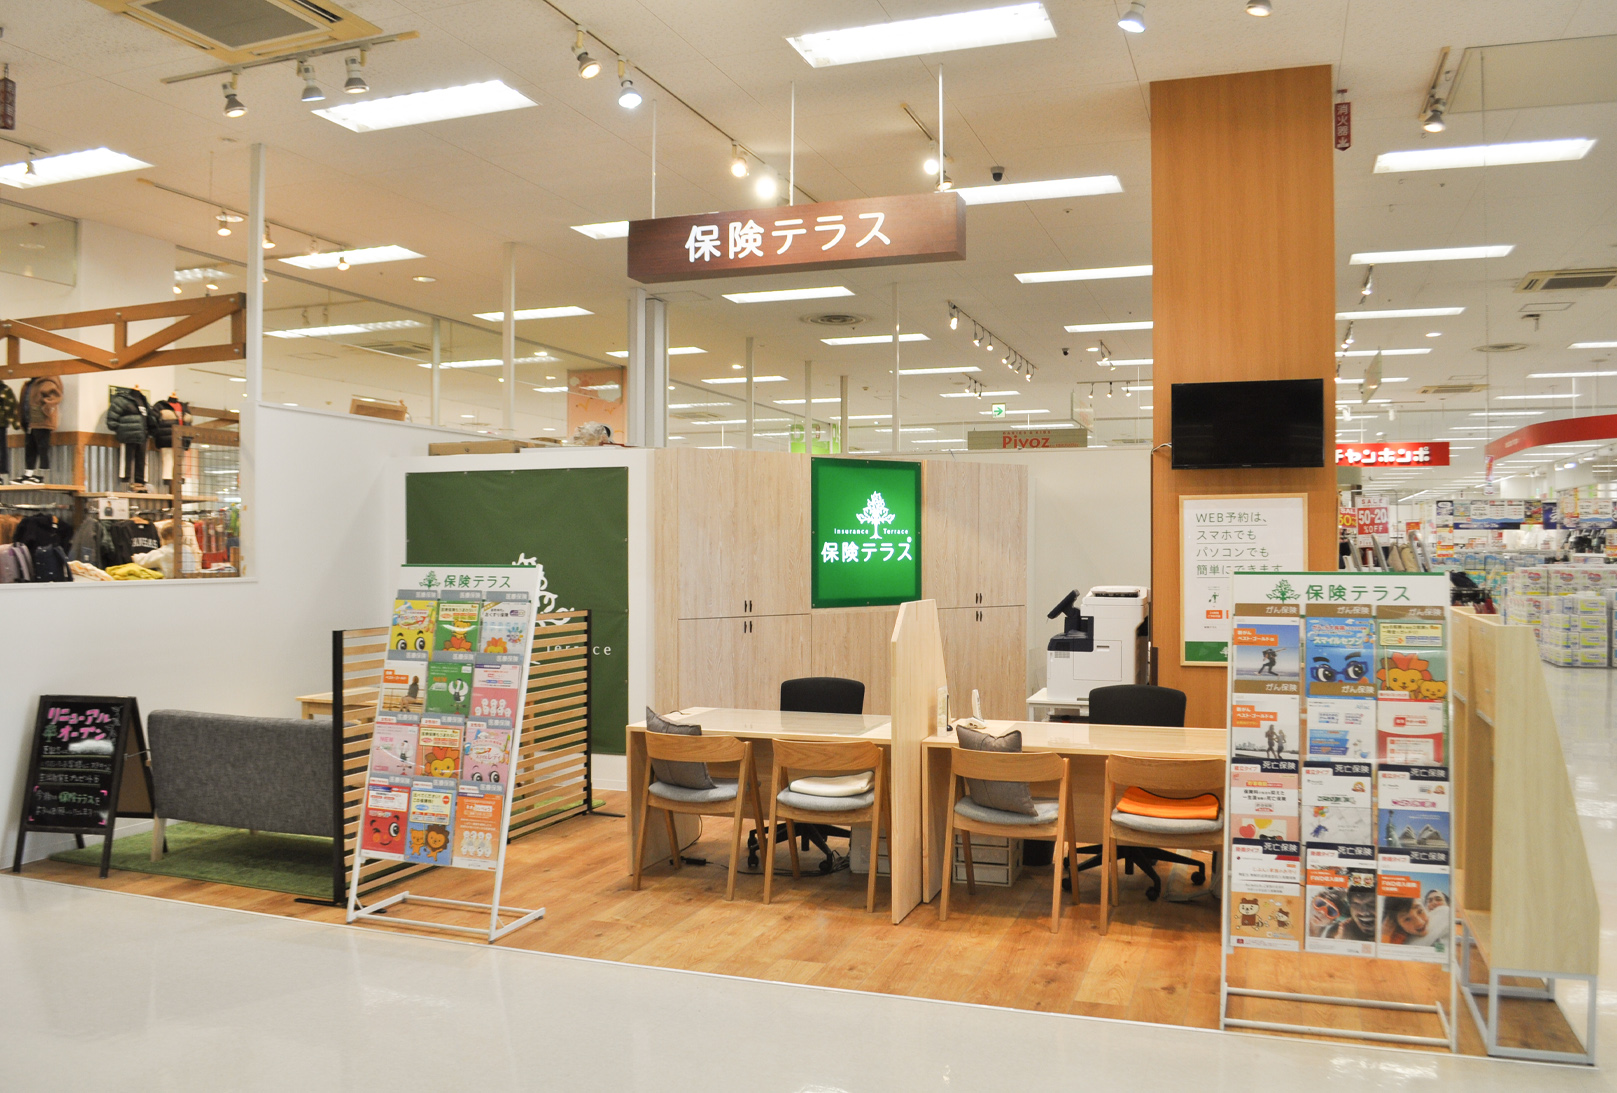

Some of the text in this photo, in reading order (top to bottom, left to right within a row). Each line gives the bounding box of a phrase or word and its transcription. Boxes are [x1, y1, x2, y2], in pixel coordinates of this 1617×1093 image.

[1337, 104, 1349, 136] 消火器
[685, 212, 891, 263] 保険テラス
[1195, 511, 1268, 523] WEB予約は、
[1196, 529, 1257, 541] スマホでも
[821, 541, 912, 563] 保険テラス
[1196, 546, 1270, 558] パソコンでも
[444, 574, 511, 589] 保険テラス
[1305, 584, 1411, 602] 保険テラス
[1265, 605, 1298, 615] がん保険
[1336, 606, 1370, 615] がん保険
[1408, 608, 1442, 616] がん保険
[1265, 683, 1298, 692] がん保険
[1341, 685, 1375, 694] がん保険
[47, 707, 112, 725] リニューアル
[57, 725, 107, 742] オープン
[1262, 760, 1297, 771] 死亡保険
[1334, 764, 1370, 774] 死亡保険
[1410, 767, 1446, 778] 死亡保険
[1263, 841, 1299, 853] 死亡保険
[1337, 845, 1373, 857] 死亡保険
[1409, 850, 1447, 862] 死亡保険
